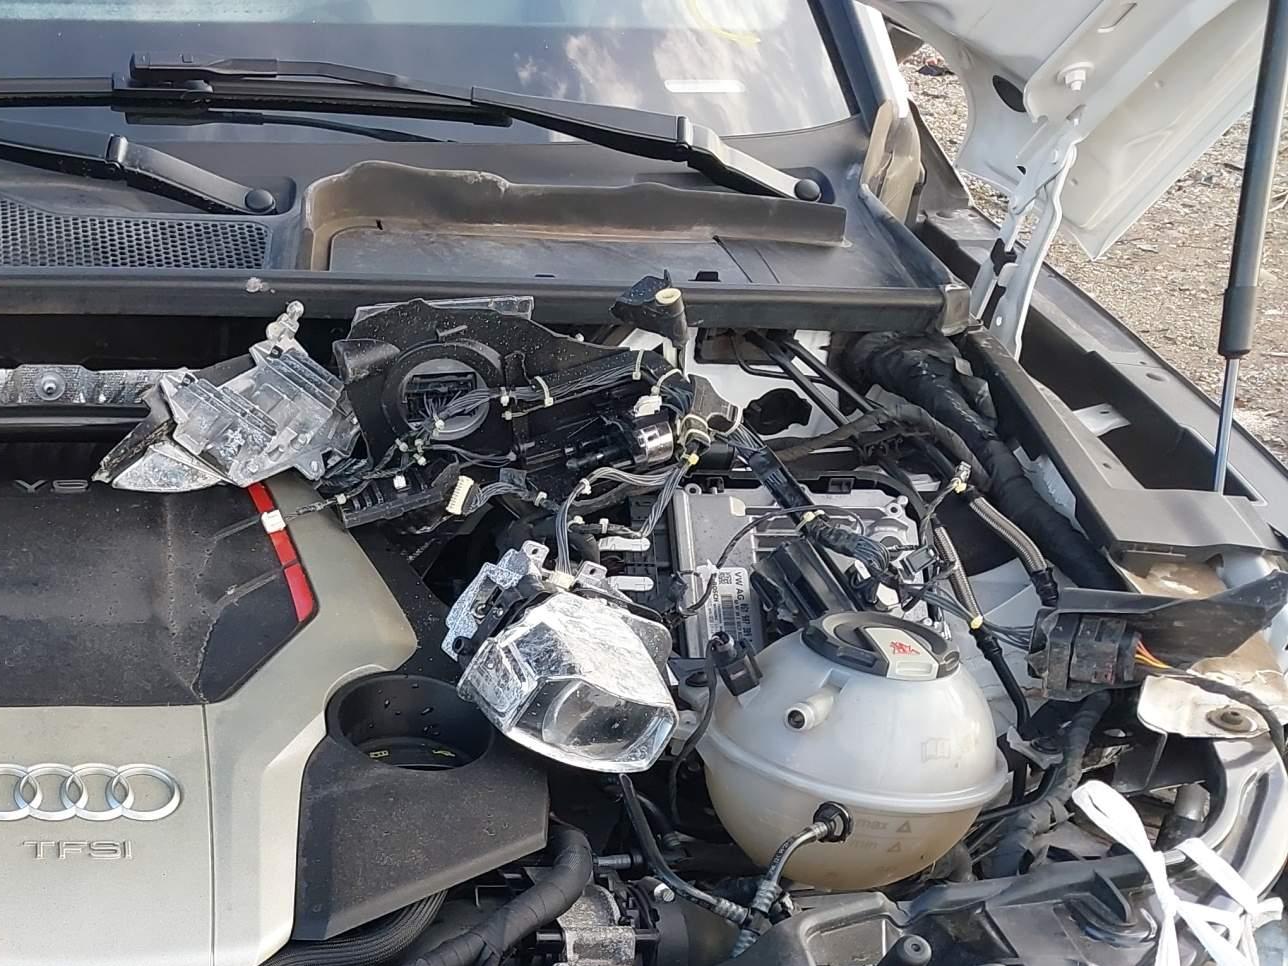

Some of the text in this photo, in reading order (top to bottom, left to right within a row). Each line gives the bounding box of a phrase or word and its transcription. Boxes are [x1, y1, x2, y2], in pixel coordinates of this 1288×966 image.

[734, 571, 743, 586] VW
[735, 588, 745, 600] AG
[22, 840, 133, 860] TFSI
